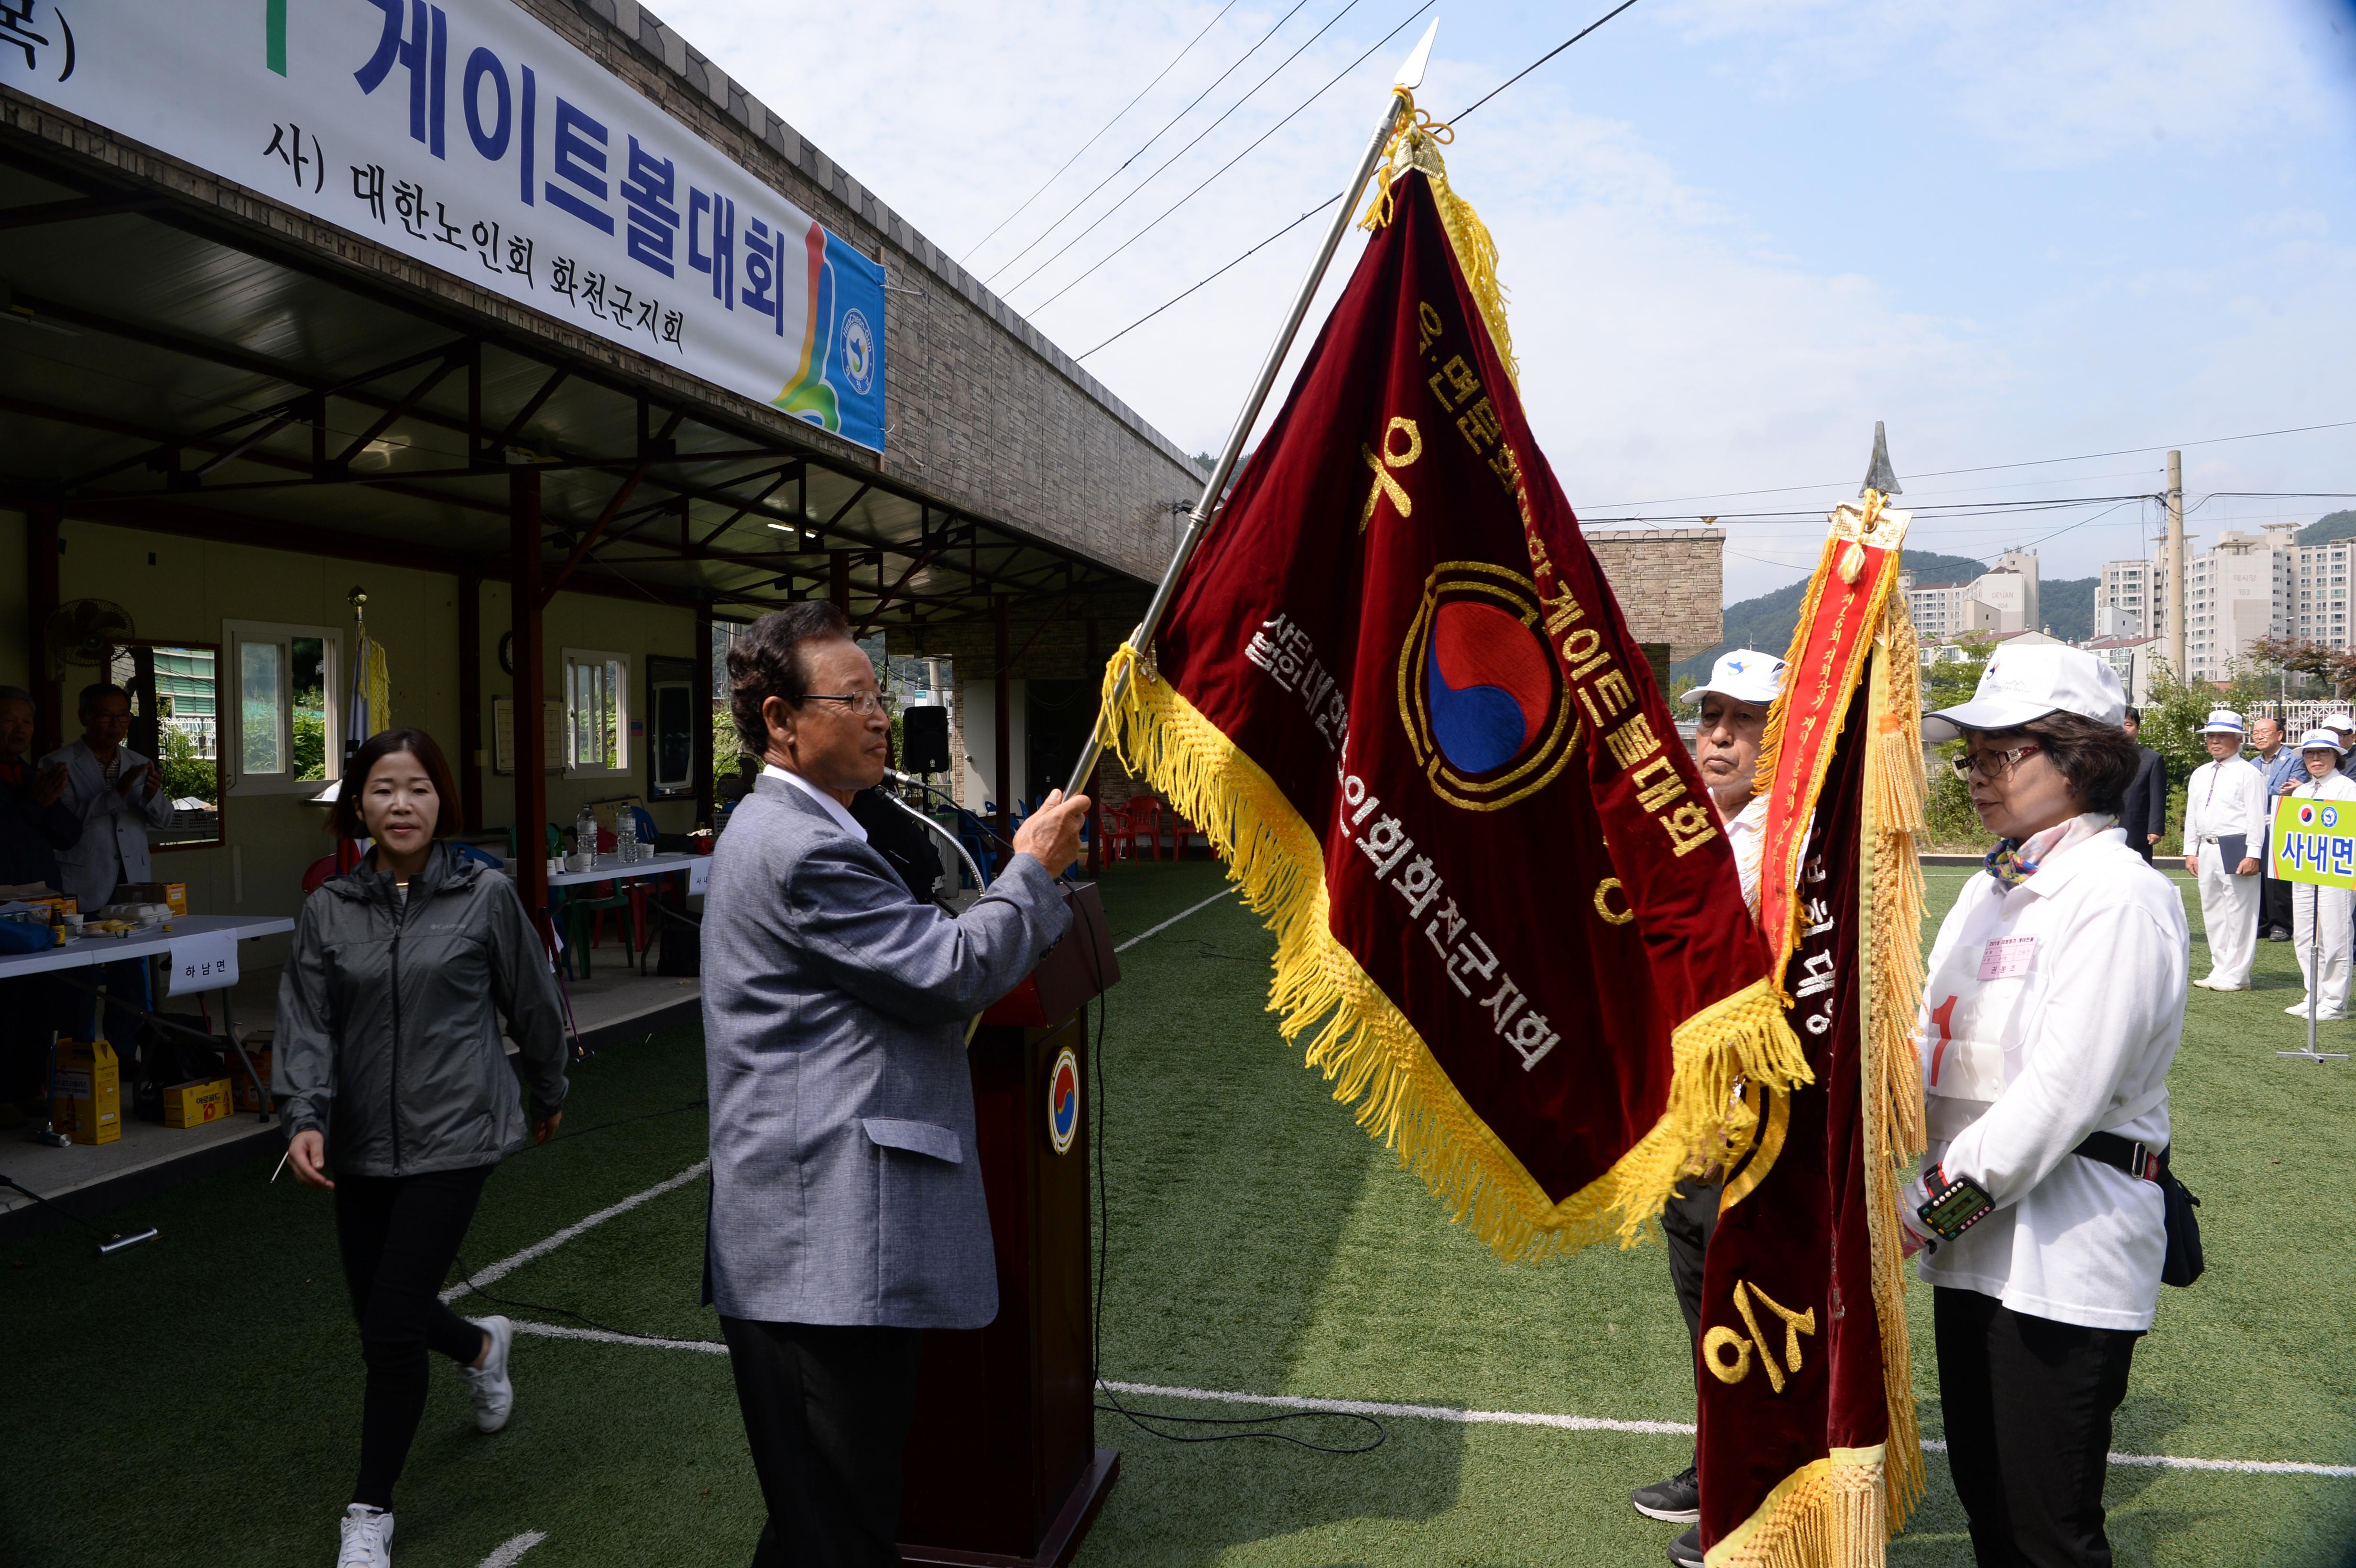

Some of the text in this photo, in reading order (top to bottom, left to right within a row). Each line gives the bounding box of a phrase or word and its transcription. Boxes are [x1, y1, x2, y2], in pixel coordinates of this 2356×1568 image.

[353, 0, 784, 337] 게이트볼대회
[263, 123, 684, 355] 사) 대한노인회 화천군지회
[1828, 591, 1855, 645] 제16회
[1539, 579, 1718, 858] 게이트볼대회
[1811, 647, 1836, 713] 지회장기
[2281, 832, 2354, 875] 사내면
[1931, 995, 1959, 1088] 1
